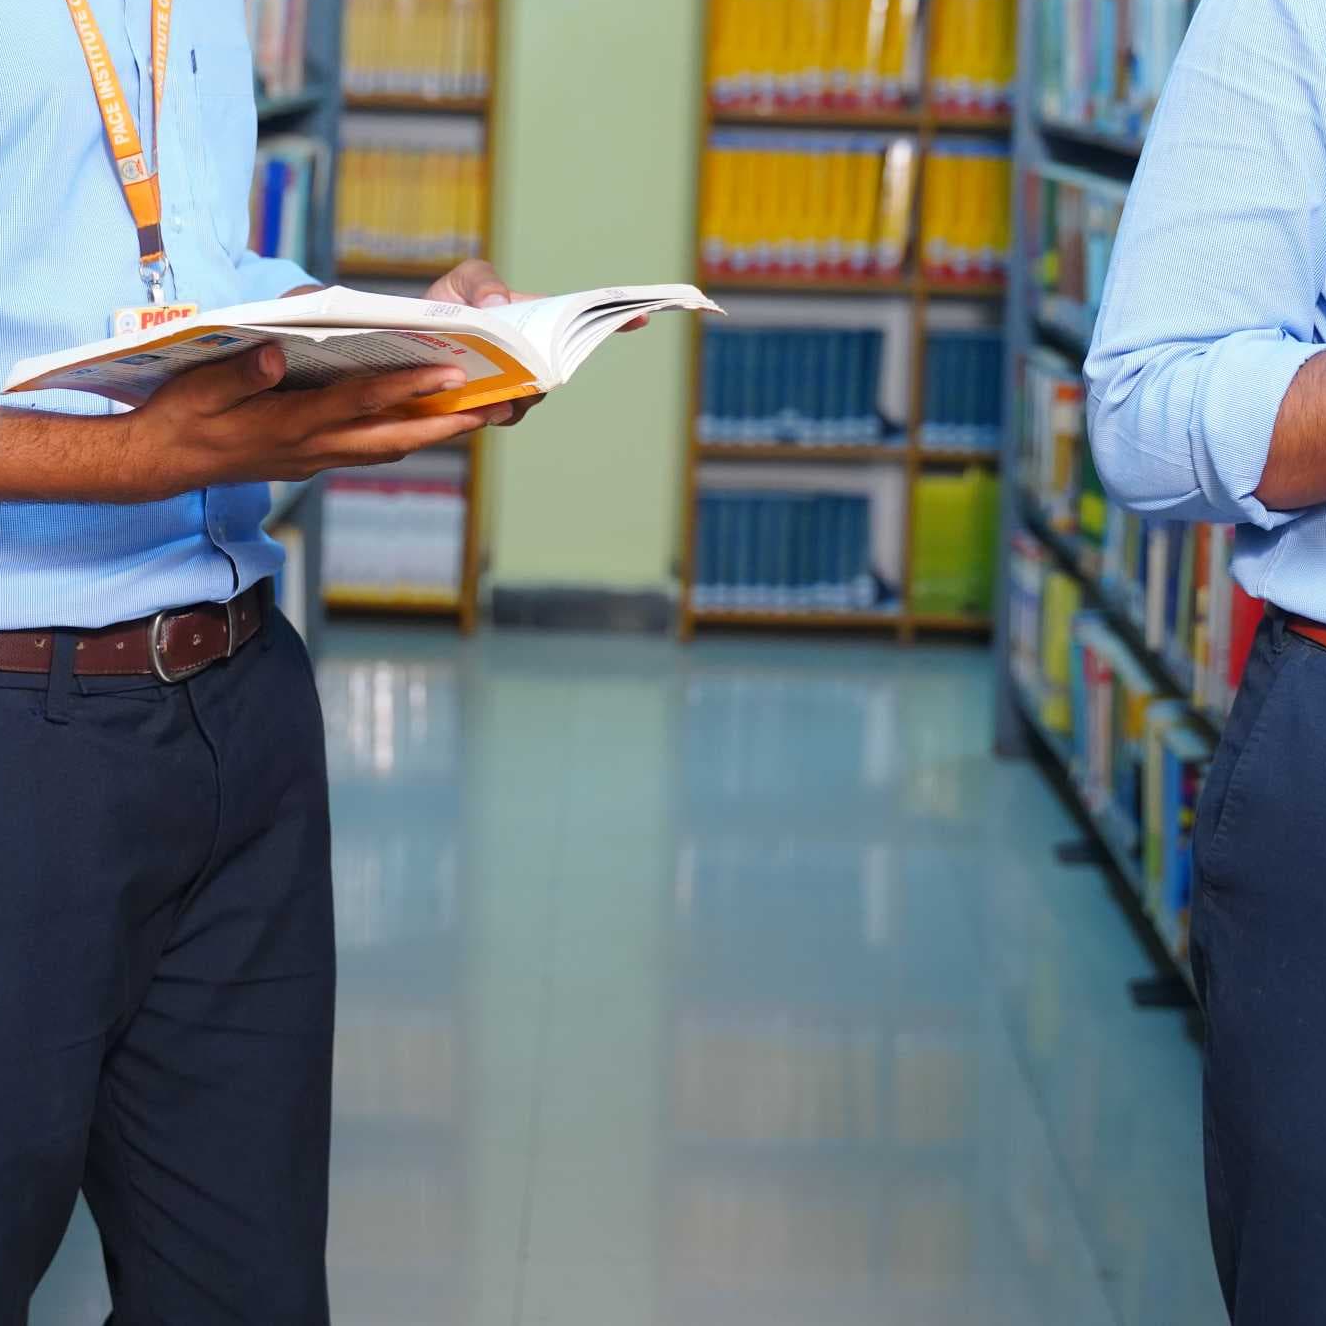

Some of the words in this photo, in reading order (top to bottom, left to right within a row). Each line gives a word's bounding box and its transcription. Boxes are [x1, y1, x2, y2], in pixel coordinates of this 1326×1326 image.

[74, 11, 116, 101] INSTITUTE
[153, 12, 170, 94] NSTITUTE
[106, 102, 131, 146] PACE
